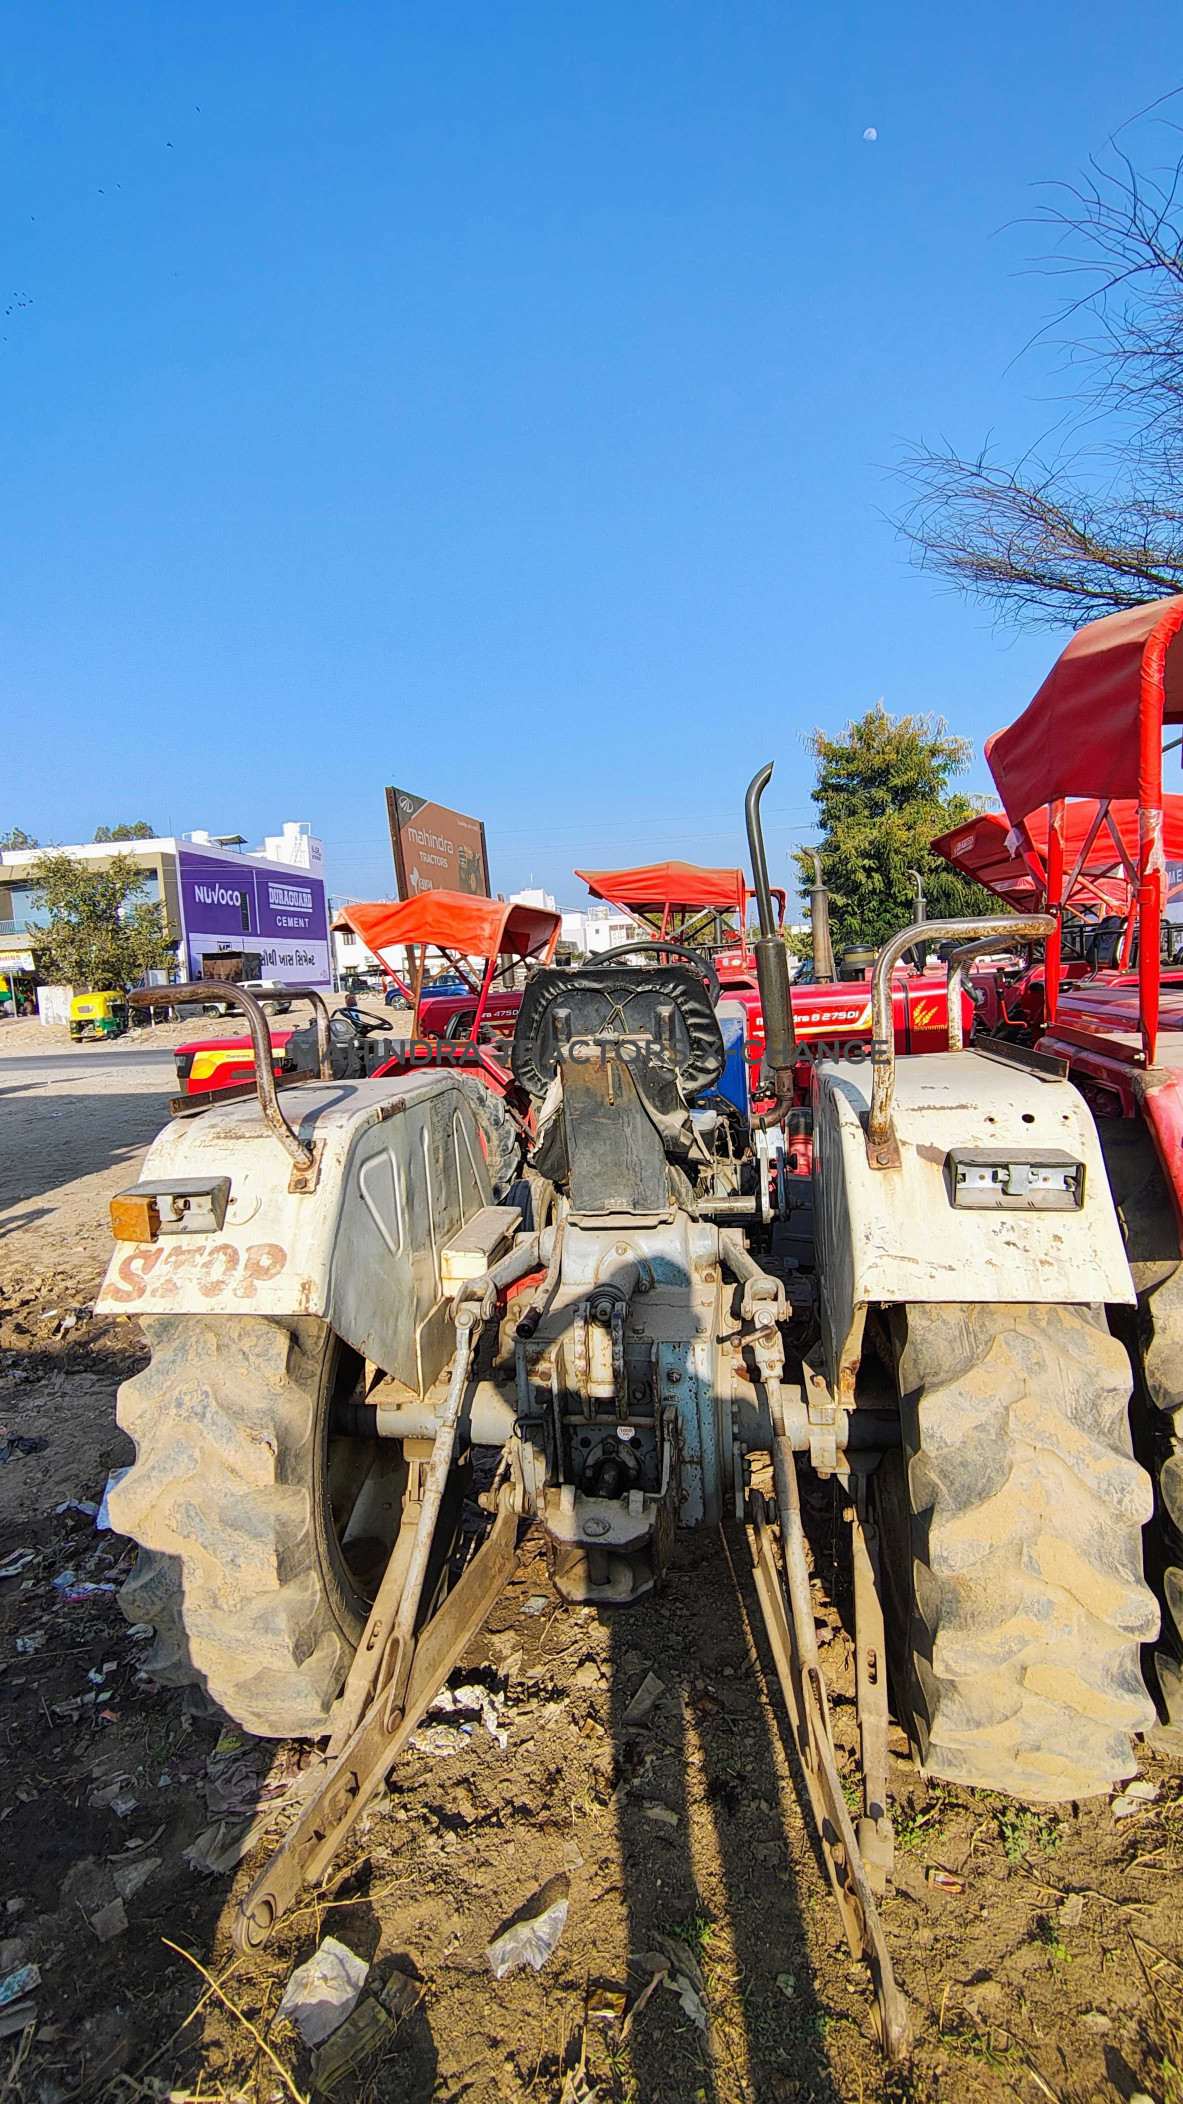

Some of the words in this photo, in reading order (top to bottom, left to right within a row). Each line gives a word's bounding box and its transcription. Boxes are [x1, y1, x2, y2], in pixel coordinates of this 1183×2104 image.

[408, 827, 454, 855] mahindra
[419, 851, 449, 869] TRACTORS
[194, 883, 241, 907] NUVOCO
[268, 887, 313, 908] DURAGUARD
[276, 916, 310, 928] CEMENT
[811, 1013, 820, 1022] B
[101, 1243, 288, 1303] STOP
